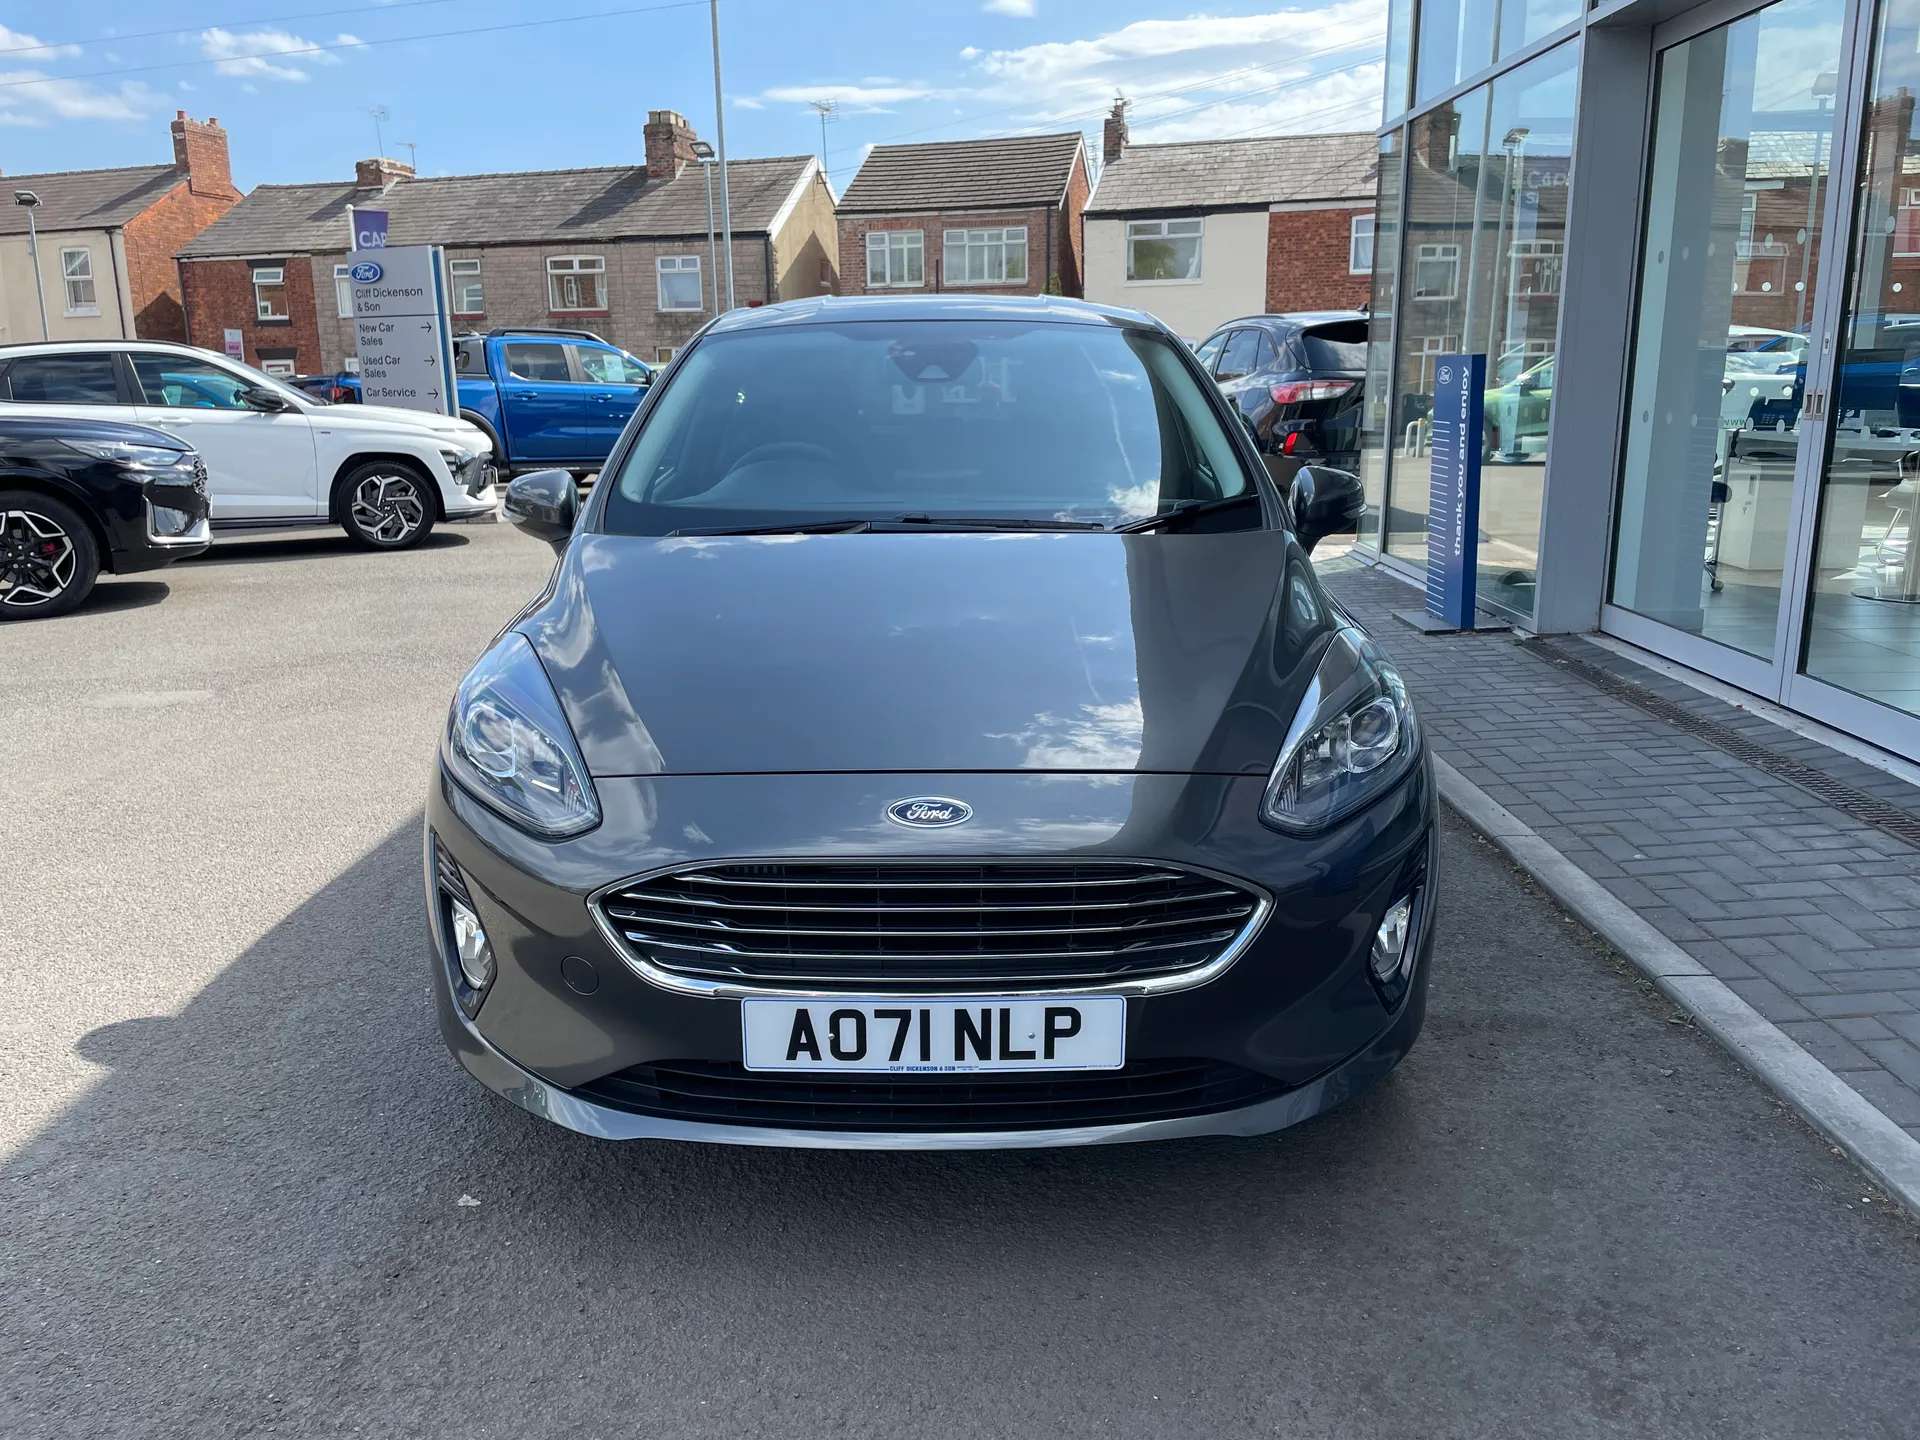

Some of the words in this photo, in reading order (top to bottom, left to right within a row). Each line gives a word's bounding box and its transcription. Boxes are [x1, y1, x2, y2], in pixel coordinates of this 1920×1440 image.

[356, 265, 374, 279] Ford
[355, 288, 371, 299] Cliff
[373, 287, 423, 298] Dickenson
[357, 303, 363, 312] &
[364, 302, 380, 311] Son
[359, 324, 377, 333] New
[378, 322, 395, 332] Car
[361, 336, 383, 346] Sales
[362, 355, 383, 365] Used
[384, 355, 400, 365] Car
[364, 368, 387, 378] Sales
[366, 388, 380, 397] Car
[381, 387, 417, 397] Service
[1461, 367, 1469, 420] enjoy
[1458, 423, 1466, 461] and
[1457, 464, 1465, 498] you
[1454, 502, 1463, 556] thank
[906, 802, 953, 820] Ford
[954, 1006, 1082, 1060] NLP
